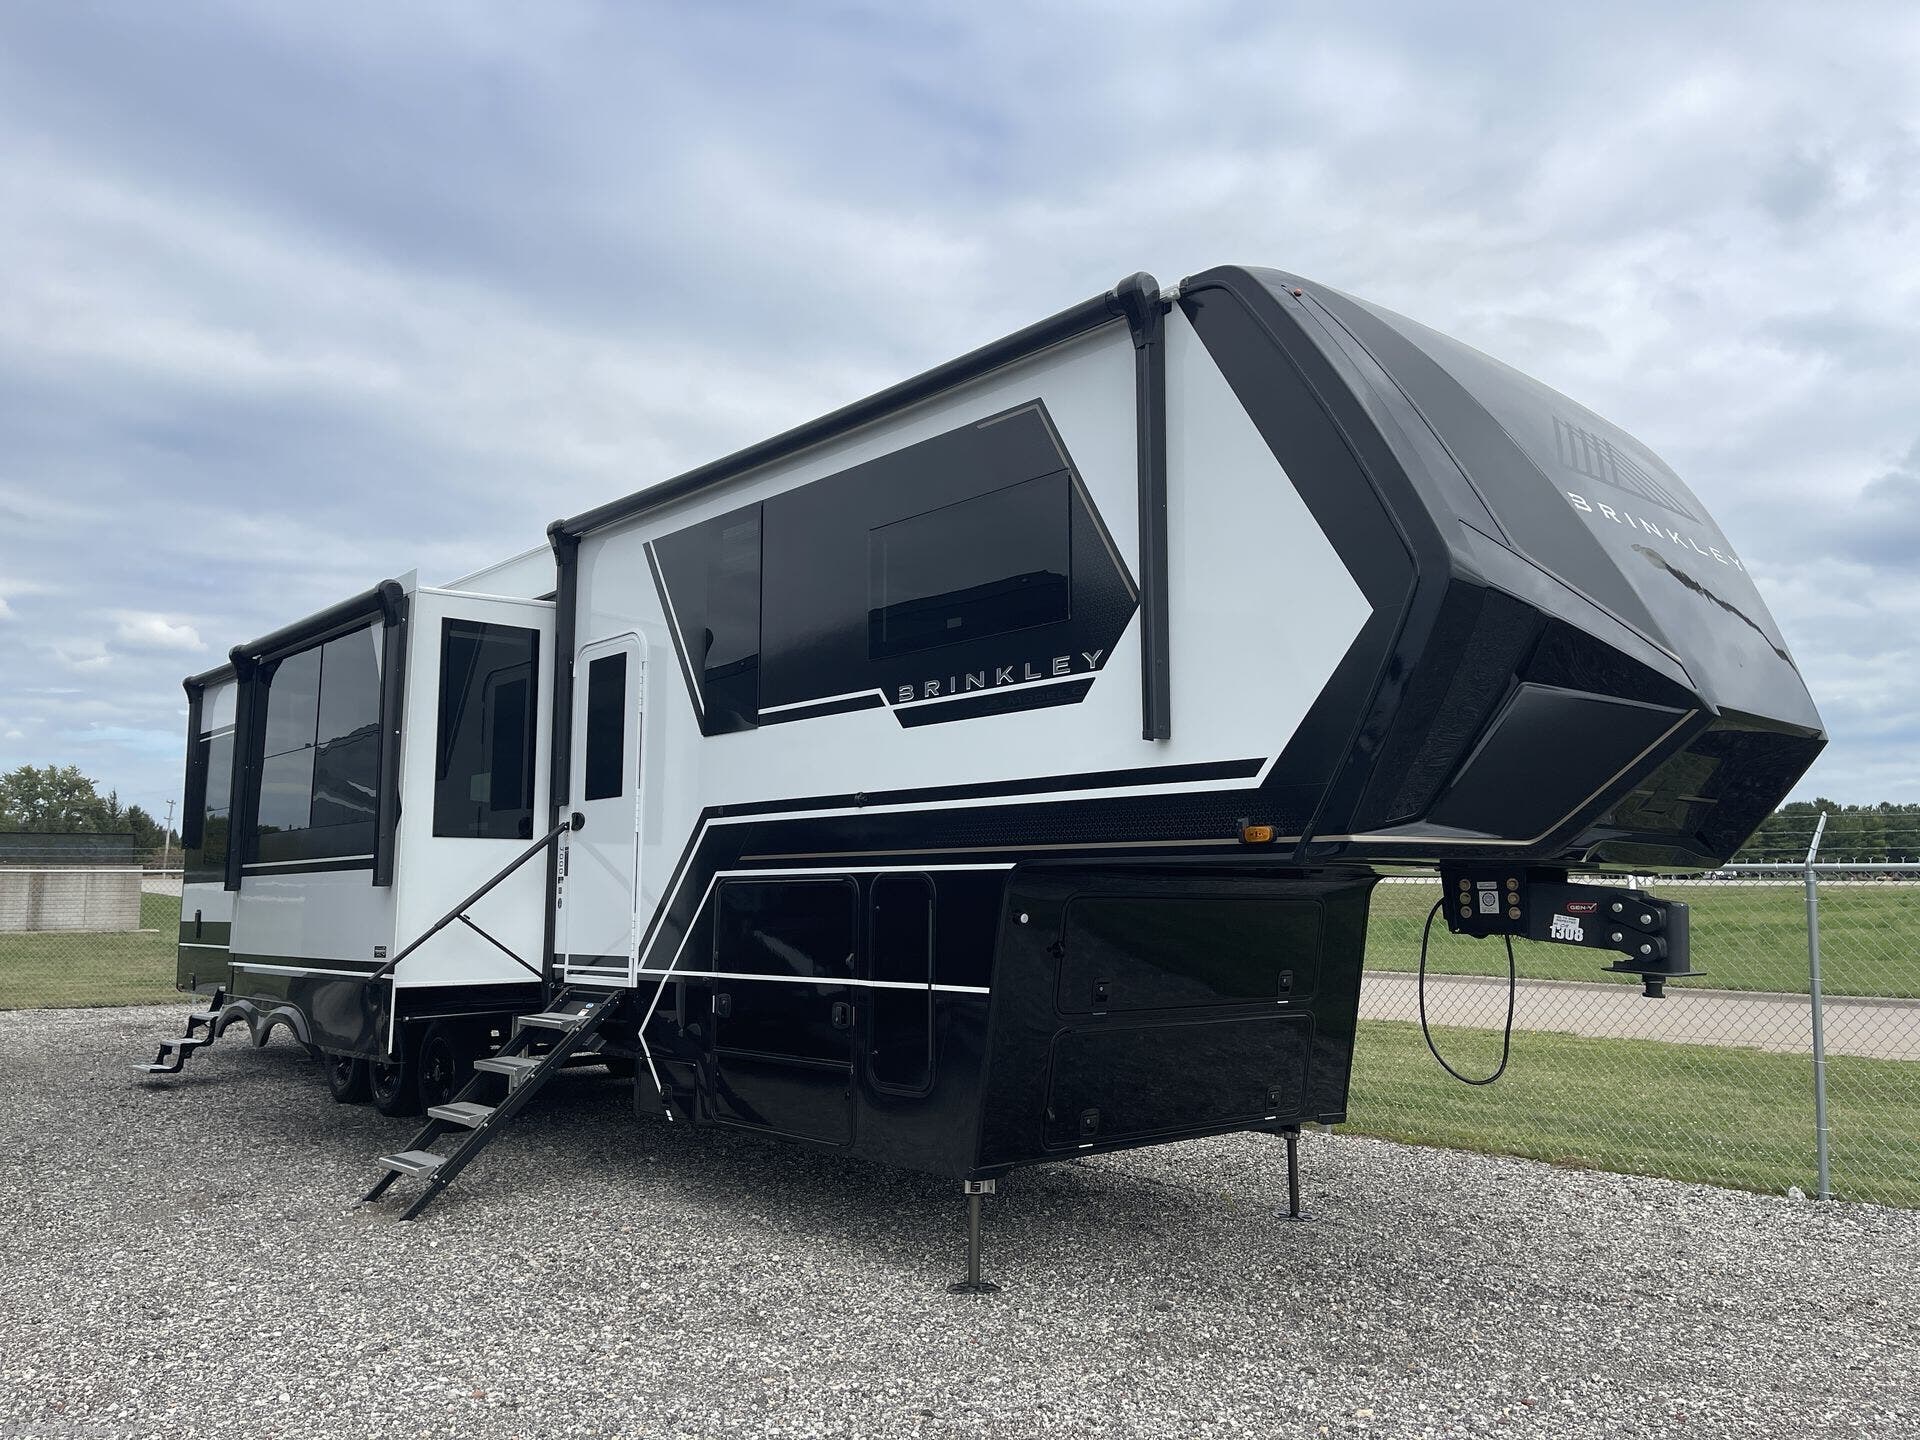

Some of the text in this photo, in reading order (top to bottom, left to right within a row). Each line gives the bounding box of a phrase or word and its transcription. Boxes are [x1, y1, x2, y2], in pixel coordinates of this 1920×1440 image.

[1567, 491, 1743, 571] BRINKLEY
[898, 649, 1103, 701] BRINKLEY
[1550, 926, 1584, 942] 1308
